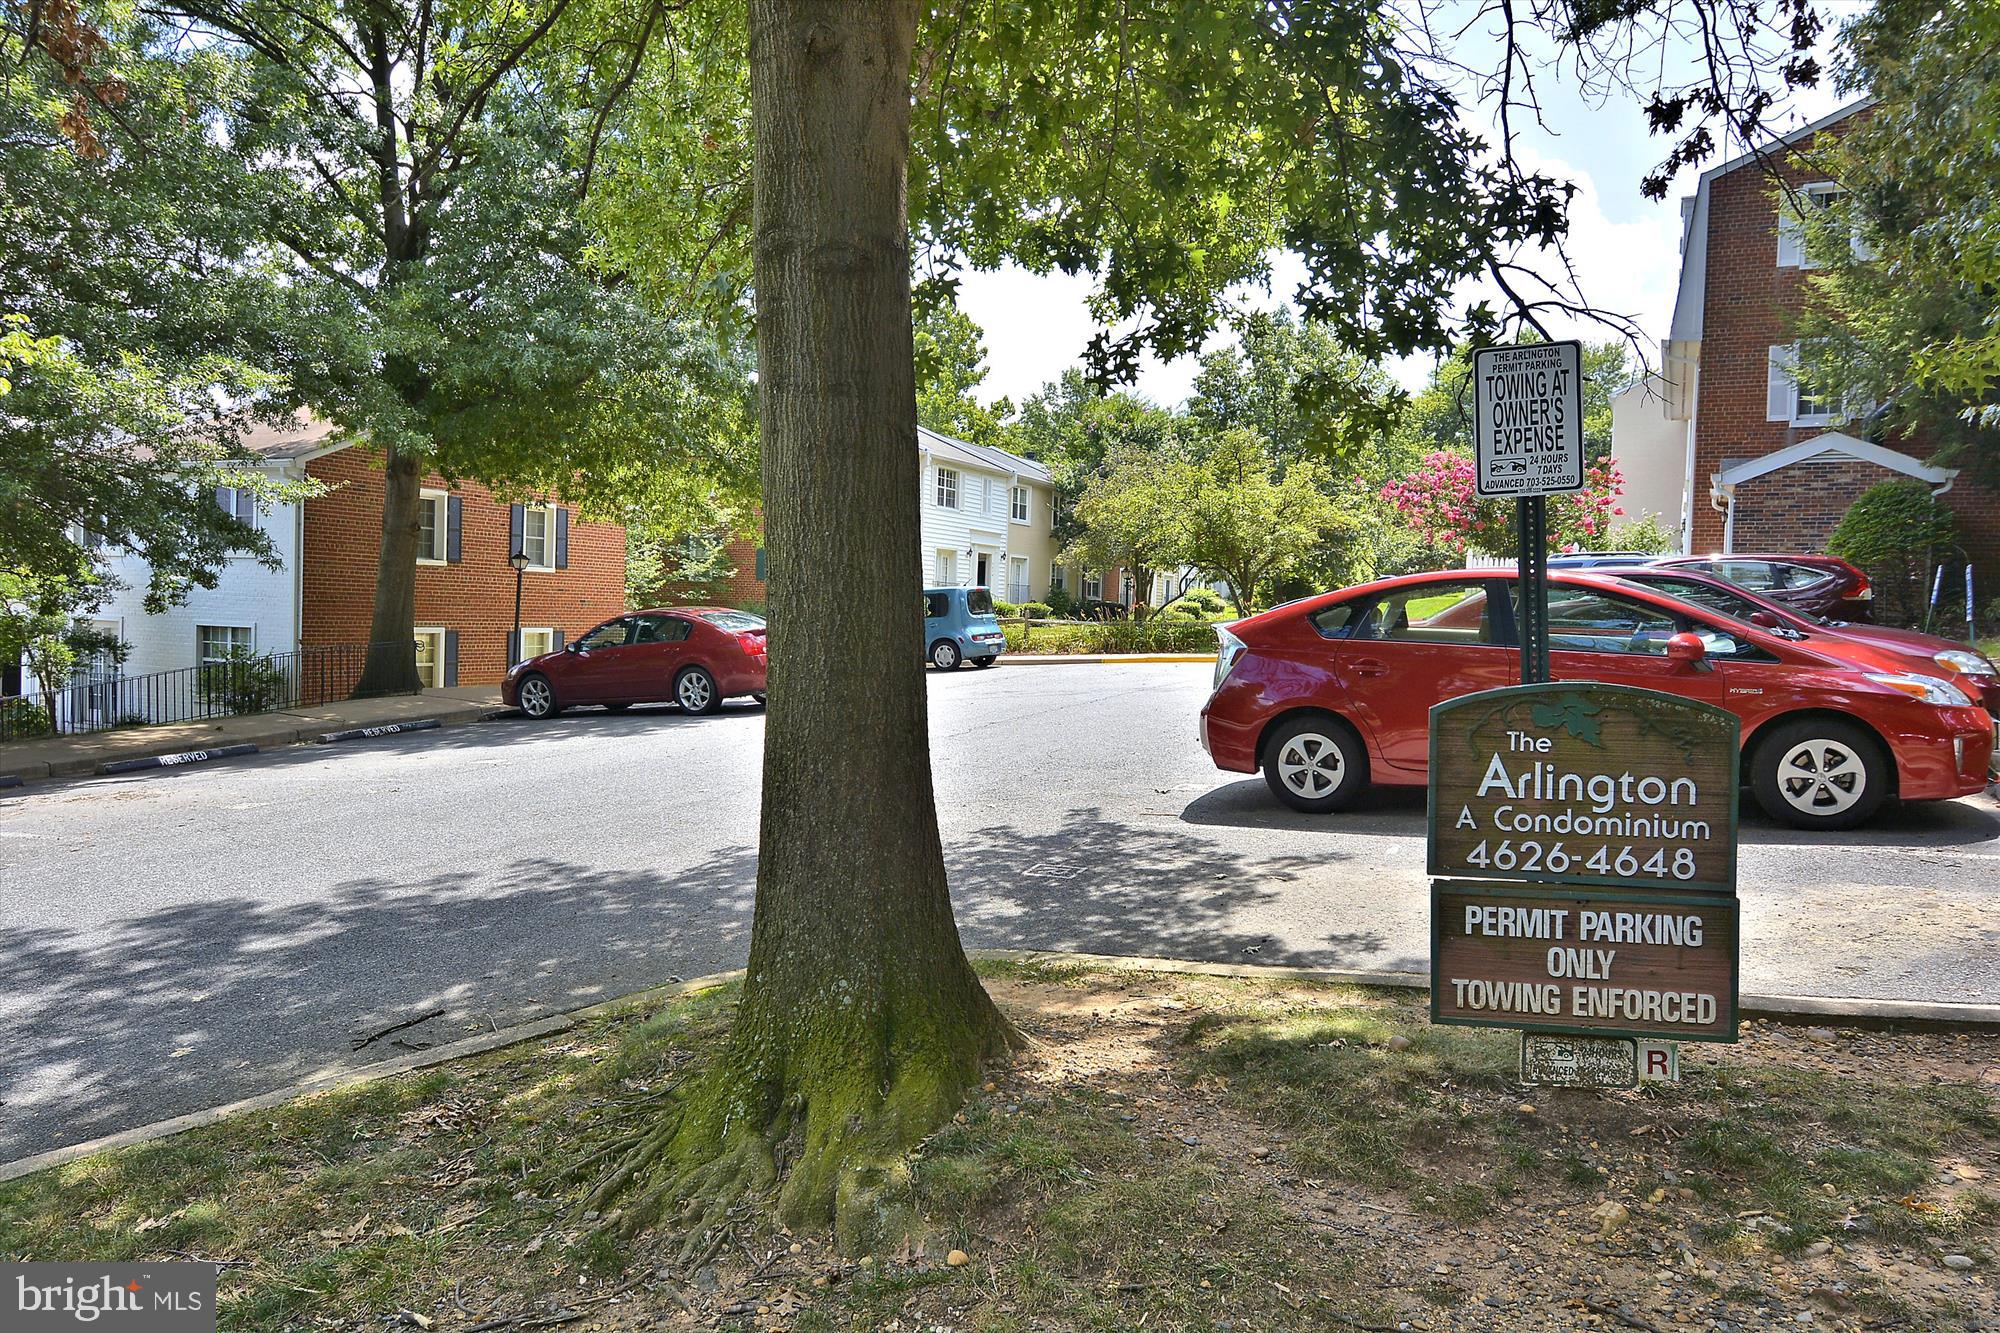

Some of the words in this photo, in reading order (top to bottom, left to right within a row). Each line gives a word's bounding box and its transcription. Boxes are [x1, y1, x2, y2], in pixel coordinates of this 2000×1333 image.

[1492, 362, 1523, 373] PERMIT
[1525, 359, 1562, 371] PARKING
[1494, 352, 1510, 362] THE
[1512, 348, 1560, 361] ARLINGTON
[1485, 371, 1547, 401] TOWING
[1551, 369, 1569, 396] AT
[1492, 397, 1564, 428] OWNER'S
[1494, 425, 1565, 455] EXPENSE
[1529, 455, 1539, 465] 24
[1541, 453, 1568, 464] HOURS
[1537, 465, 1542, 475] 7
[1542, 464, 1563, 475] DAYS
[1485, 478, 1525, 490] ADVANCED
[1526, 475, 1576, 487] 703-525-0550
[362, 724, 401, 737] RESERVED
[1506, 731, 1552, 753] The
[158, 751, 208, 766] RESERVED
[1476, 752, 1697, 813] Arlington
[1455, 804, 1478, 830] A
[1494, 805, 1711, 840] Condominium
[1466, 839, 1697, 880] 4626-4648
[1465, 905, 1568, 939] PERMIT
[1580, 911, 1704, 946] PARKING
[1547, 946, 1616, 980] ONLY
[1451, 979, 1561, 1015] TOWING
[1572, 987, 1717, 1025] ENFORCED
[1647, 1050, 1668, 1075] R
